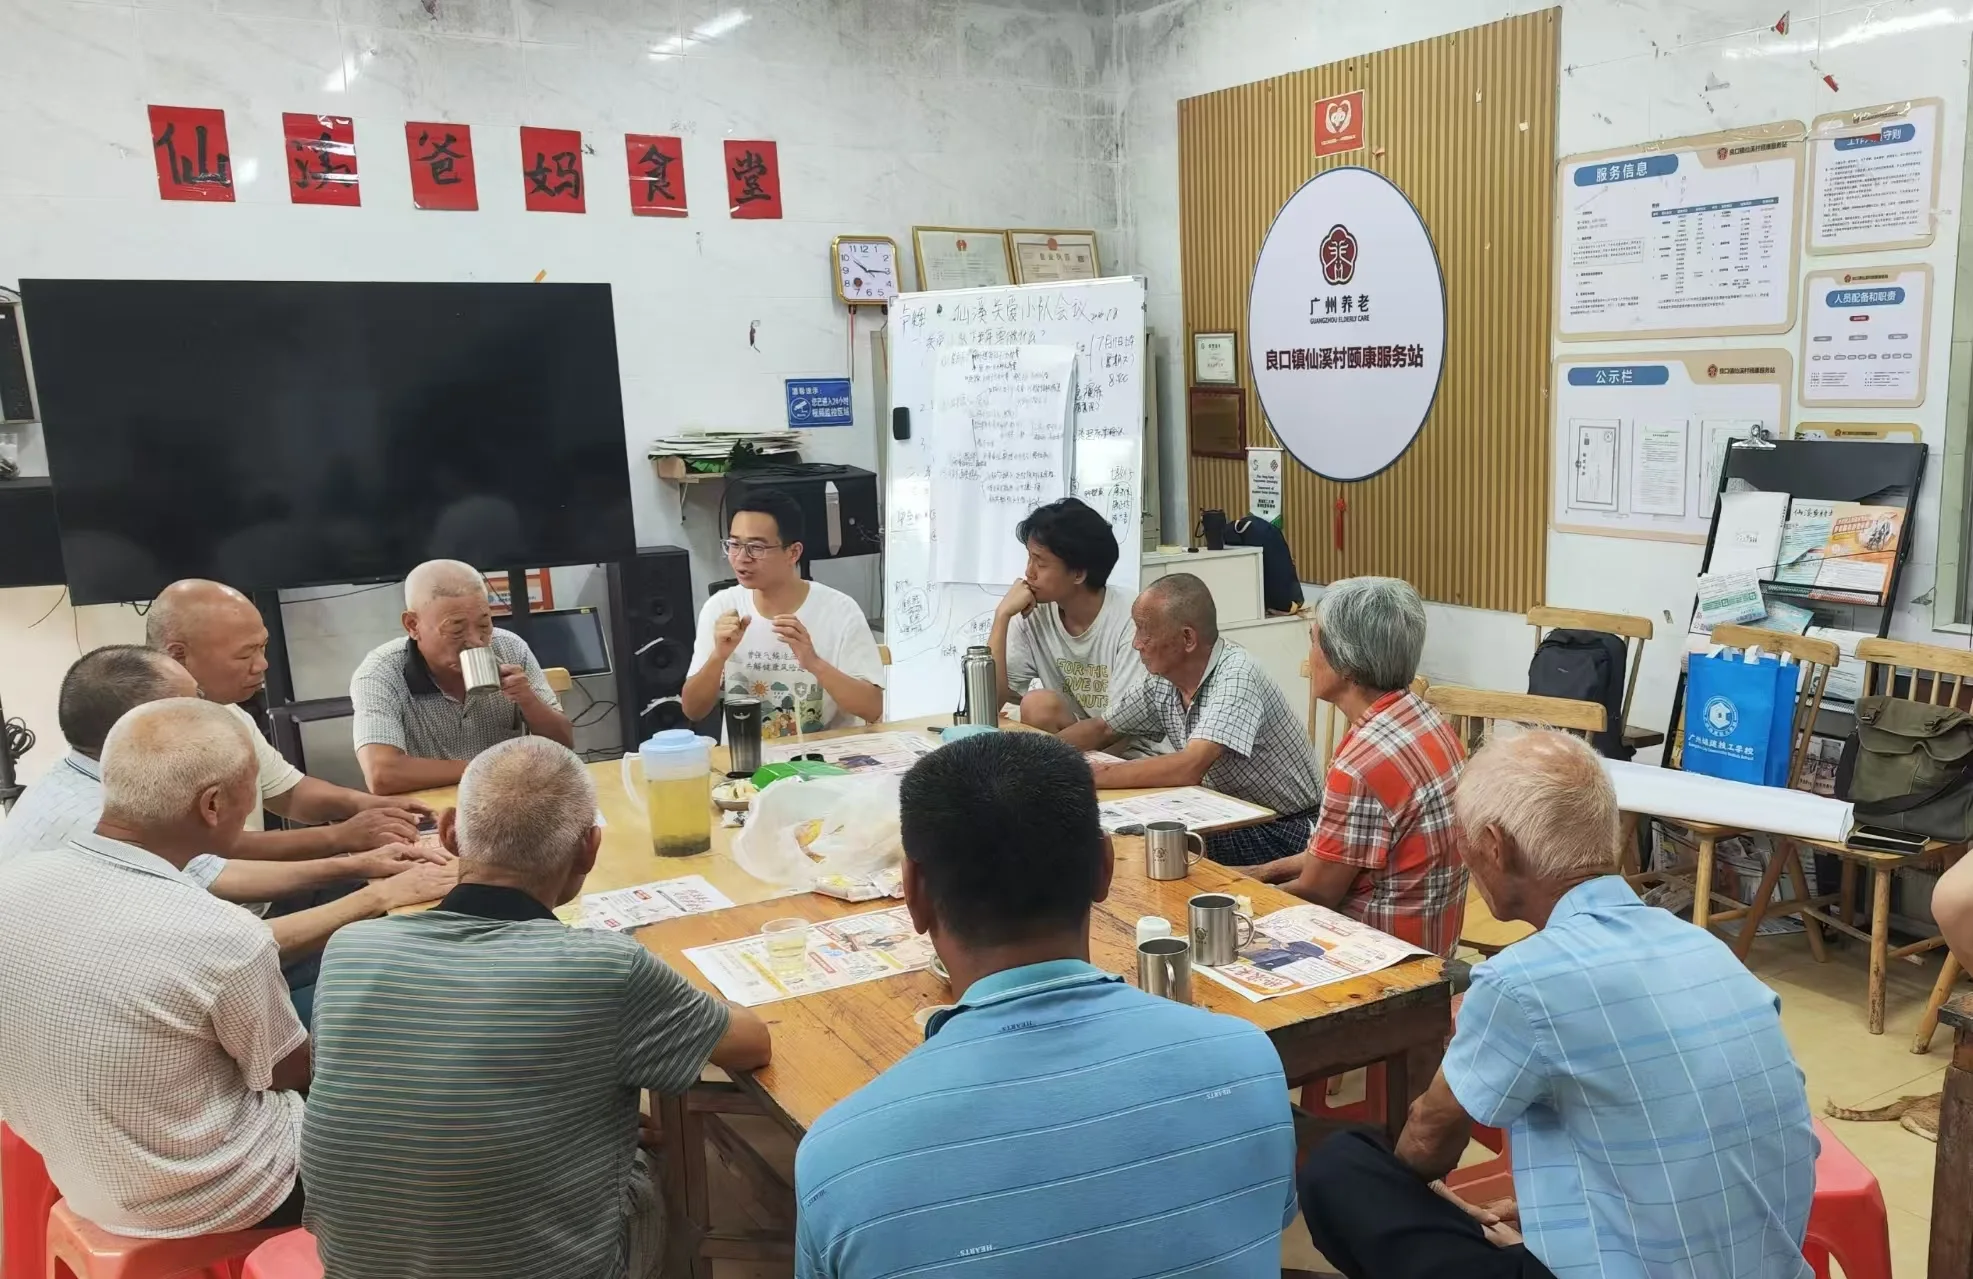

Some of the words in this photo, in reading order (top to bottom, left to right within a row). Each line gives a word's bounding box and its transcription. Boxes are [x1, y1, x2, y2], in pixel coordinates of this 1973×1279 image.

[1596, 161, 1648, 183] 服务信息
[849, 245, 857, 253] 11
[860, 245, 869, 253] 12
[841, 254, 850, 262] 10
[882, 254, 889, 262] 2
[842, 267, 850, 275] 9
[884, 267, 891, 275] 3
[853, 288, 861, 296] 7
[865, 288, 873, 297] 6
[877, 288, 885, 297] 5
[1834, 290, 1897, 305] 人员配备和职责
[1310, 294, 1370, 316] 广州养老
[1310, 317, 1338, 325] GUANGZHOU
[1338, 315, 1357, 323] ELDERLY
[1358, 314, 1370, 322] CARE
[1266, 344, 1424, 370] 良口镇仙溪村颐康服务站
[1595, 369, 1633, 384] 公示栏
[1056, 658, 1084, 676] FOR
